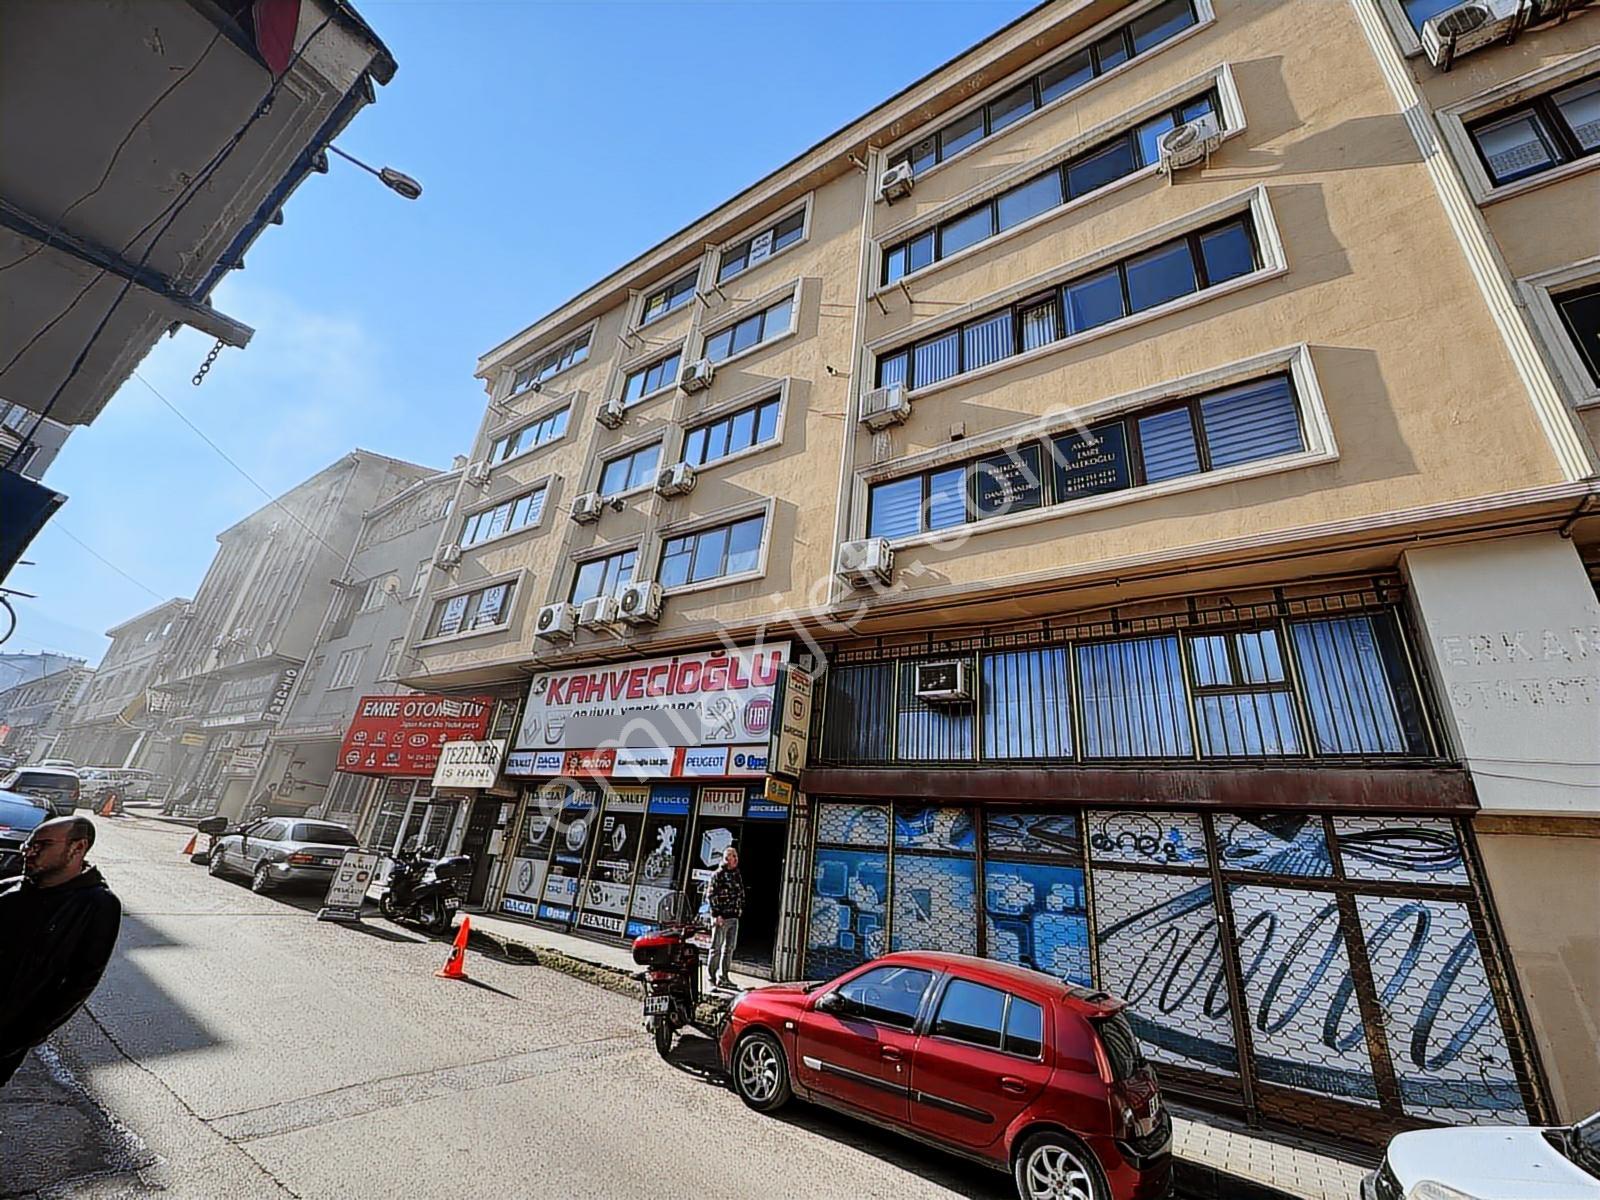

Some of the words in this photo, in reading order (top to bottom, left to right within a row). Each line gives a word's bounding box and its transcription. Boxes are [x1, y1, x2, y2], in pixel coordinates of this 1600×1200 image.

[545, 650, 782, 706] KAHVECİOĞLU
[363, 702, 401, 717] EMRE
[748, 706, 770, 726] FIAT
[444, 745, 498, 765] TEZELLER
[537, 756, 560, 764] DACIA
[686, 756, 725, 768] PEUGEOT
[703, 791, 743, 804] MUTLU
[505, 900, 534, 914] DACIA
[583, 913, 622, 932] RENAULT
